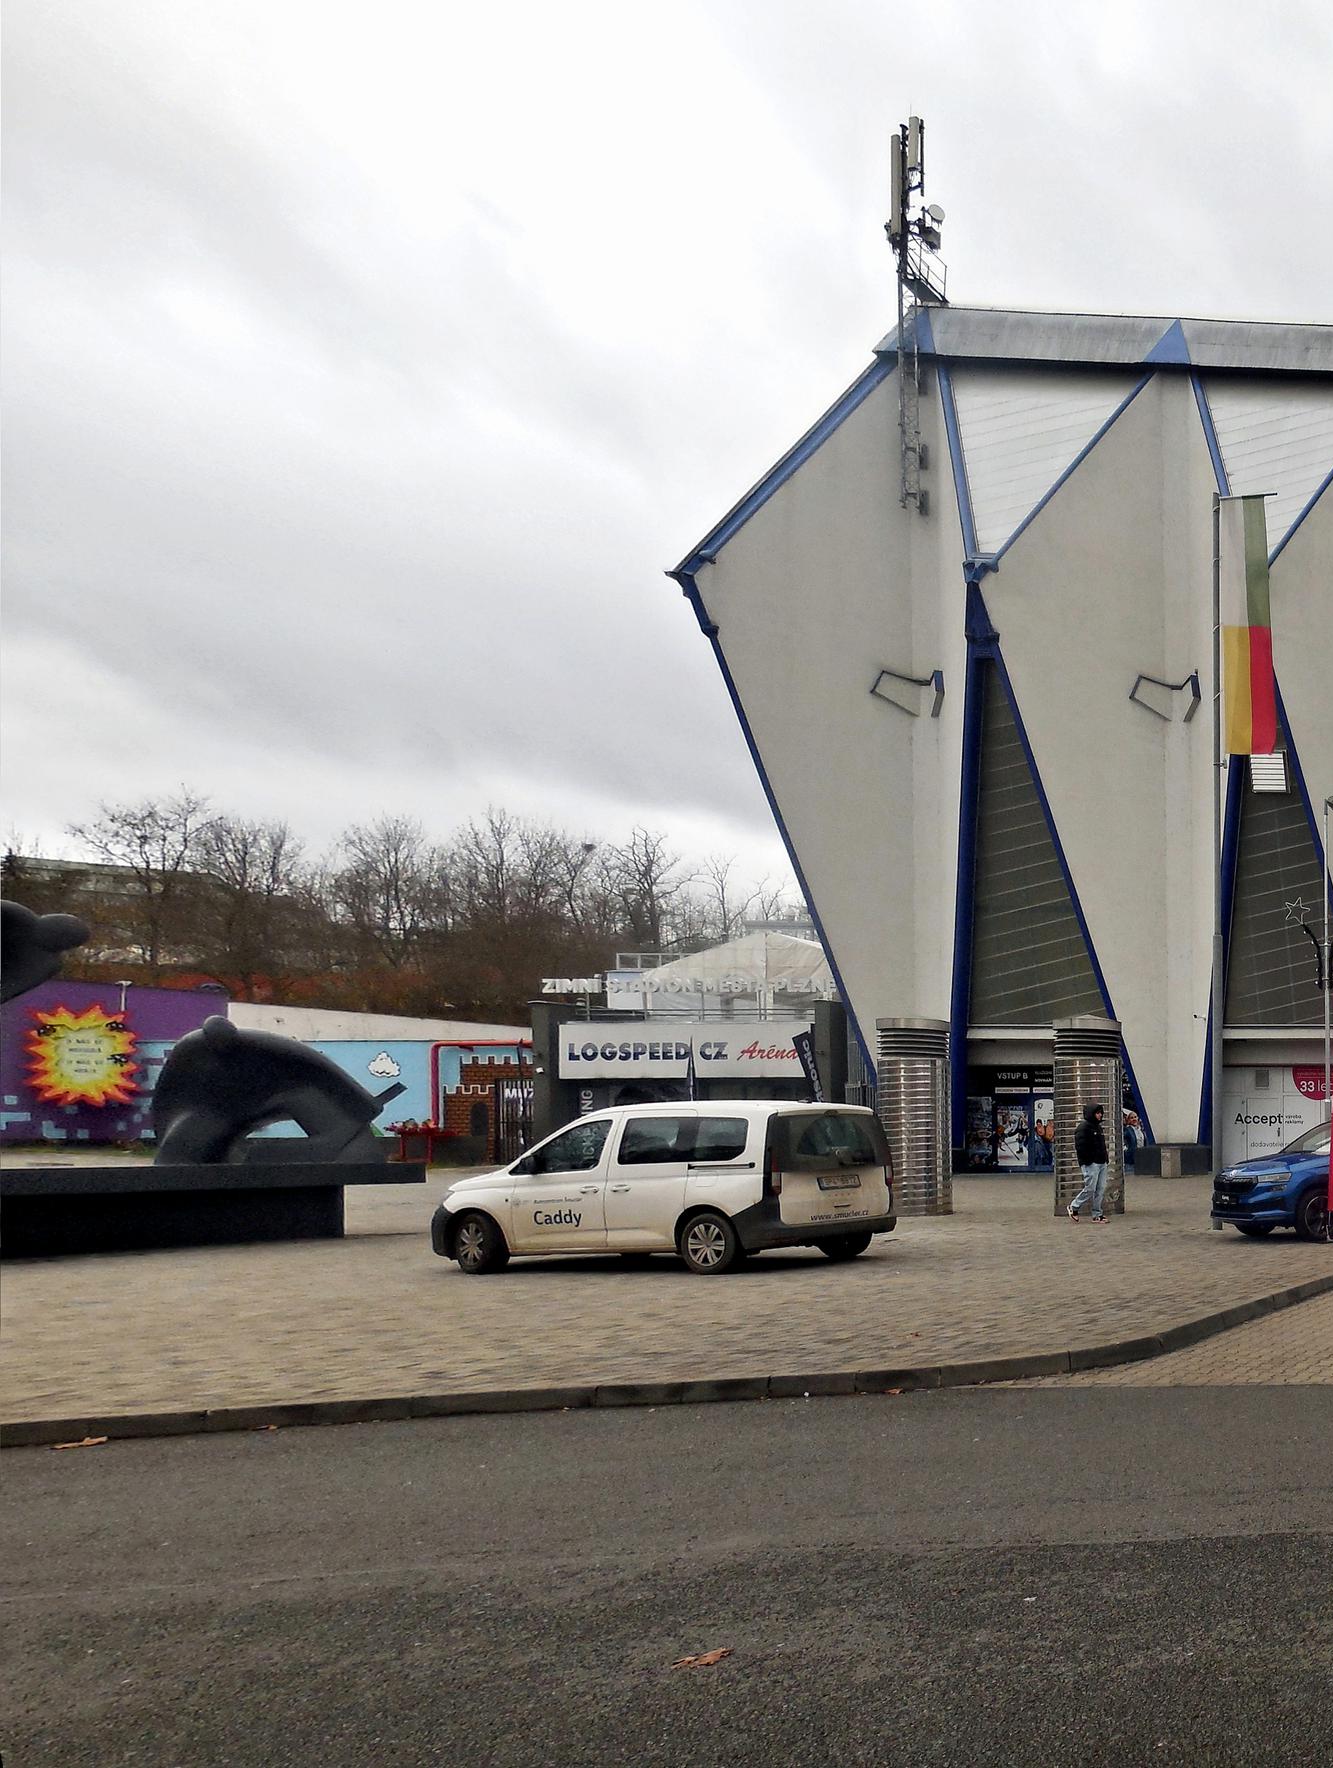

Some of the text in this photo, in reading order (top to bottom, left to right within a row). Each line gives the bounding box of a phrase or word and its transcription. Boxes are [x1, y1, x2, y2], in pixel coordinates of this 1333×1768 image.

[568, 1040, 800, 1062] LOGSPEED CZ Aréna
[997, 1072, 1021, 1080] VSTUP
[1300, 1081, 1315, 1092] 33
[1234, 1113, 1284, 1127] Accept
[533, 1209, 582, 1228] Caddy
